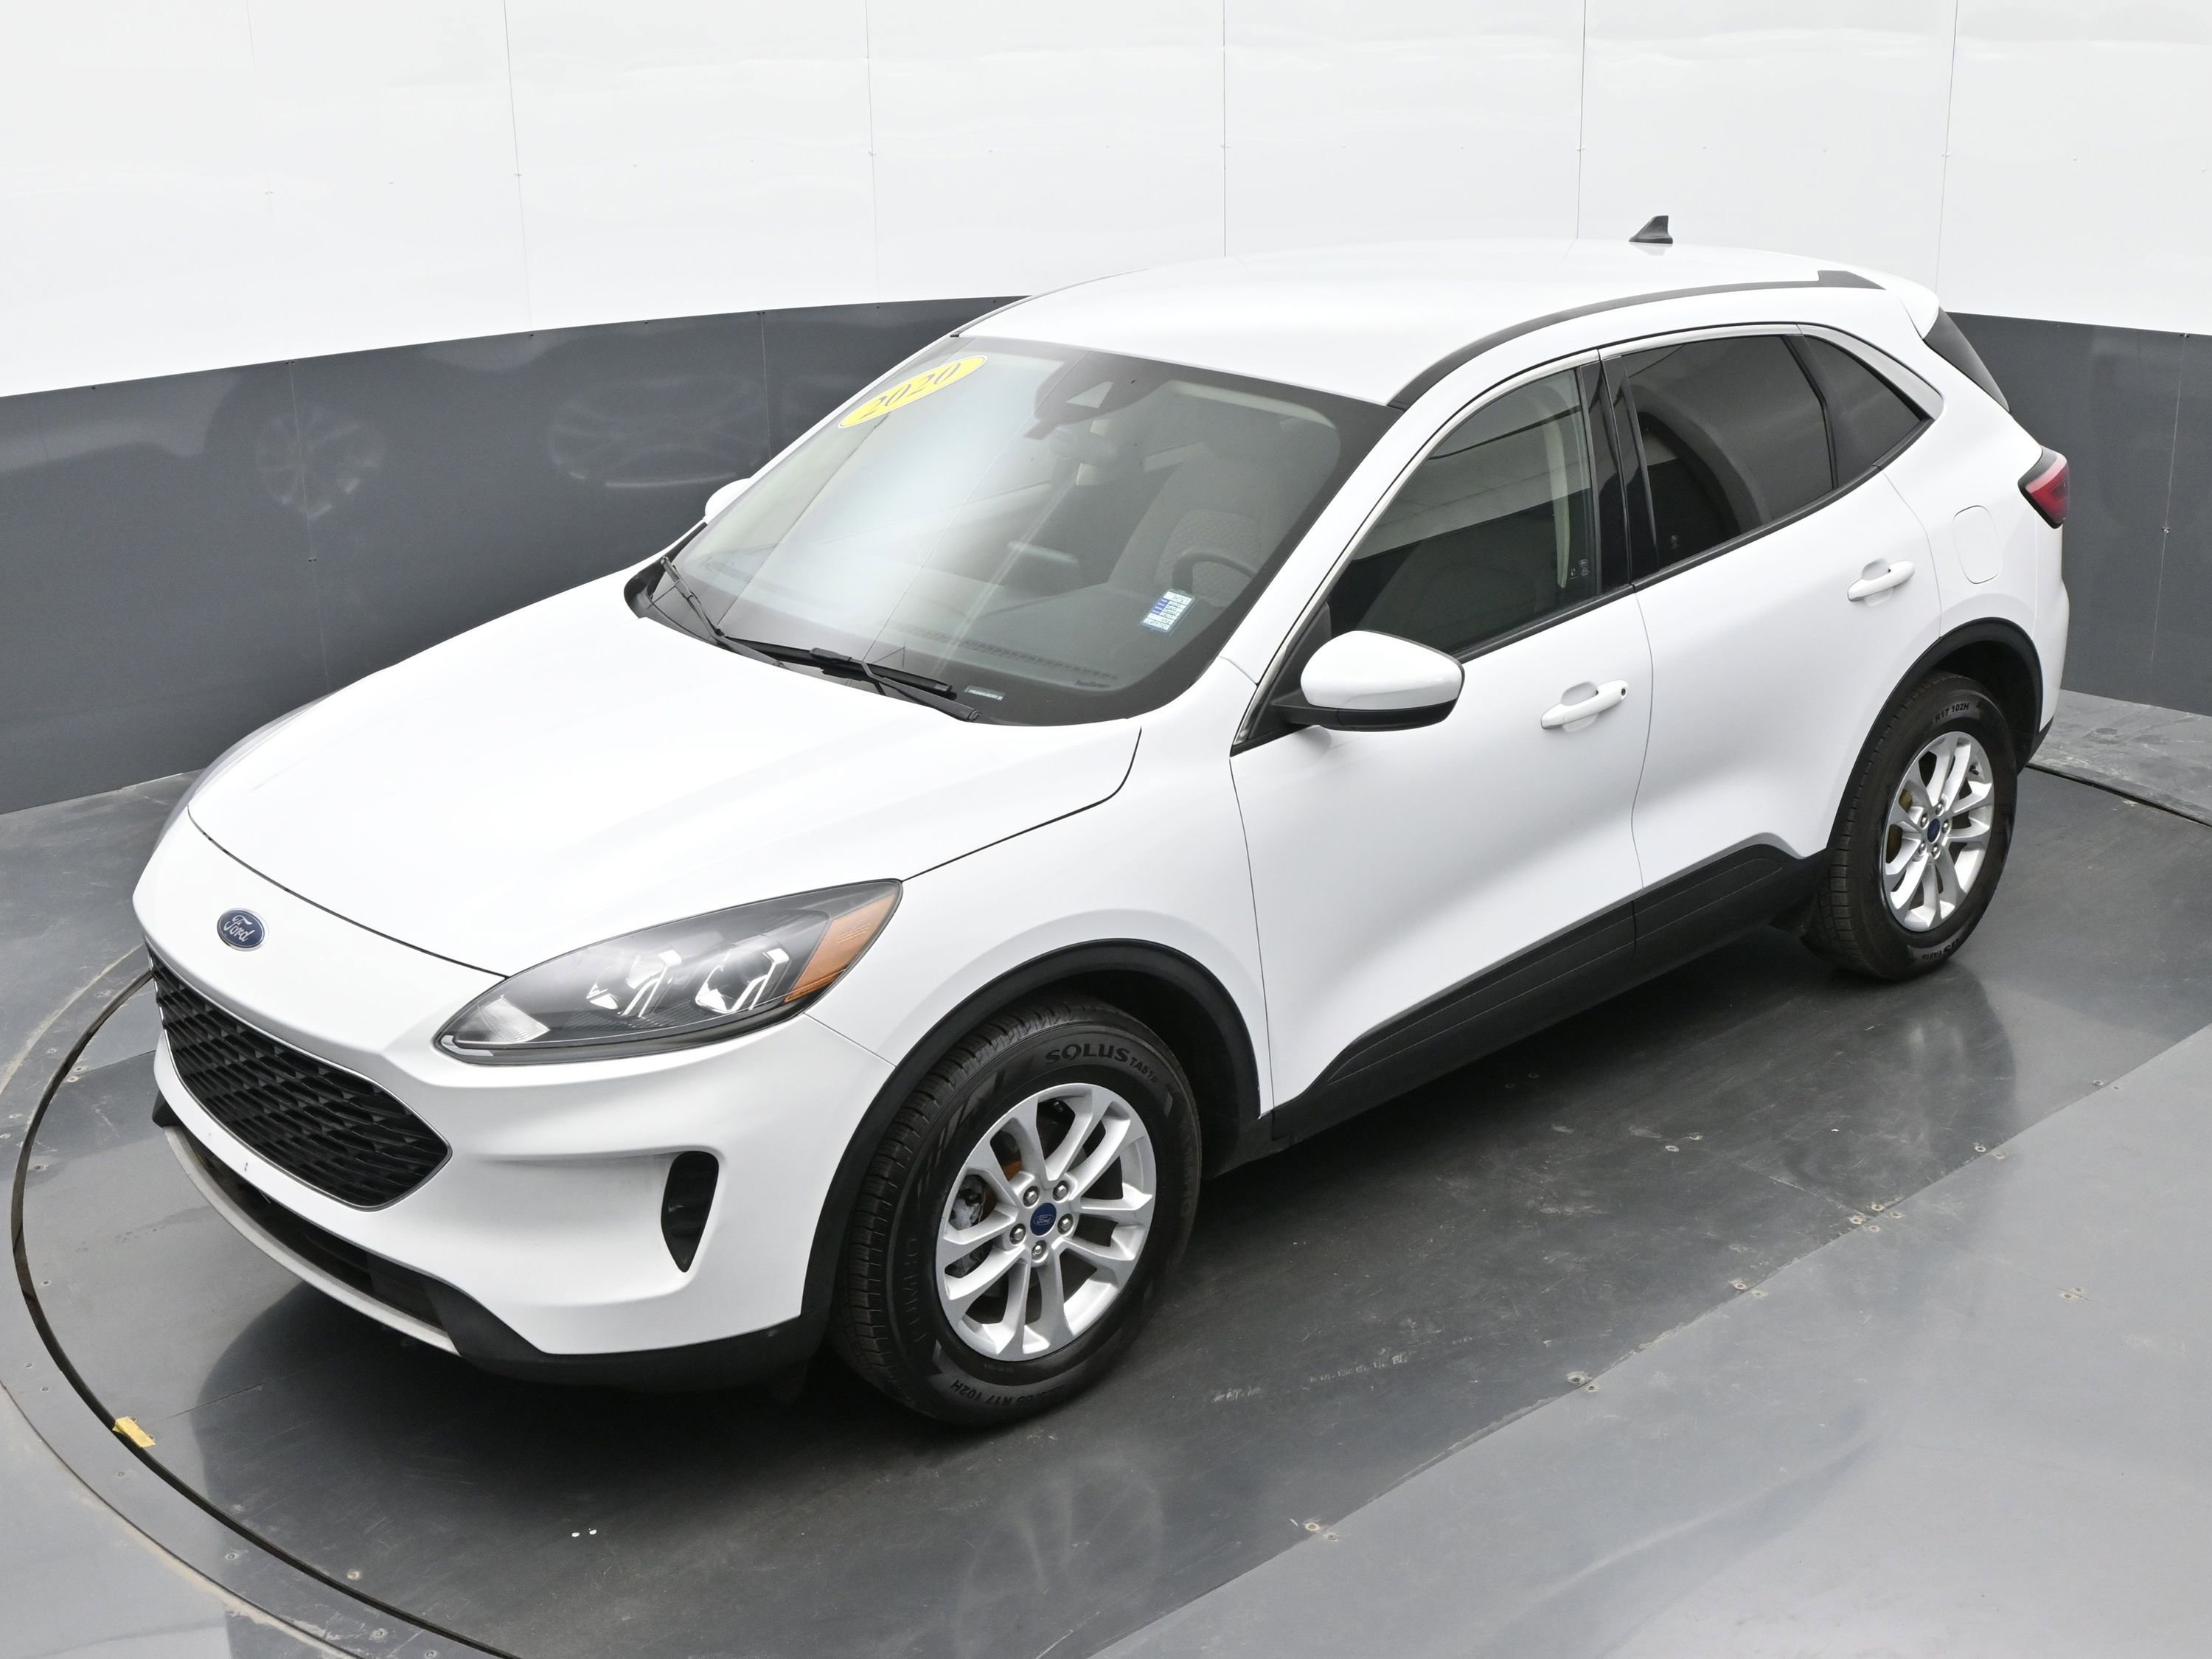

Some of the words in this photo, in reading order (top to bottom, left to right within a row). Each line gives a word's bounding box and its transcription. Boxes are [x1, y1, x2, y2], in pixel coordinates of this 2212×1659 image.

[859, 363, 961, 420] 2020
[1952, 703, 1970, 713] 102H
[223, 914, 255, 942] Ford
[1045, 1043, 1130, 1065] SOLUS
[950, 1380, 983, 1401] 102H
